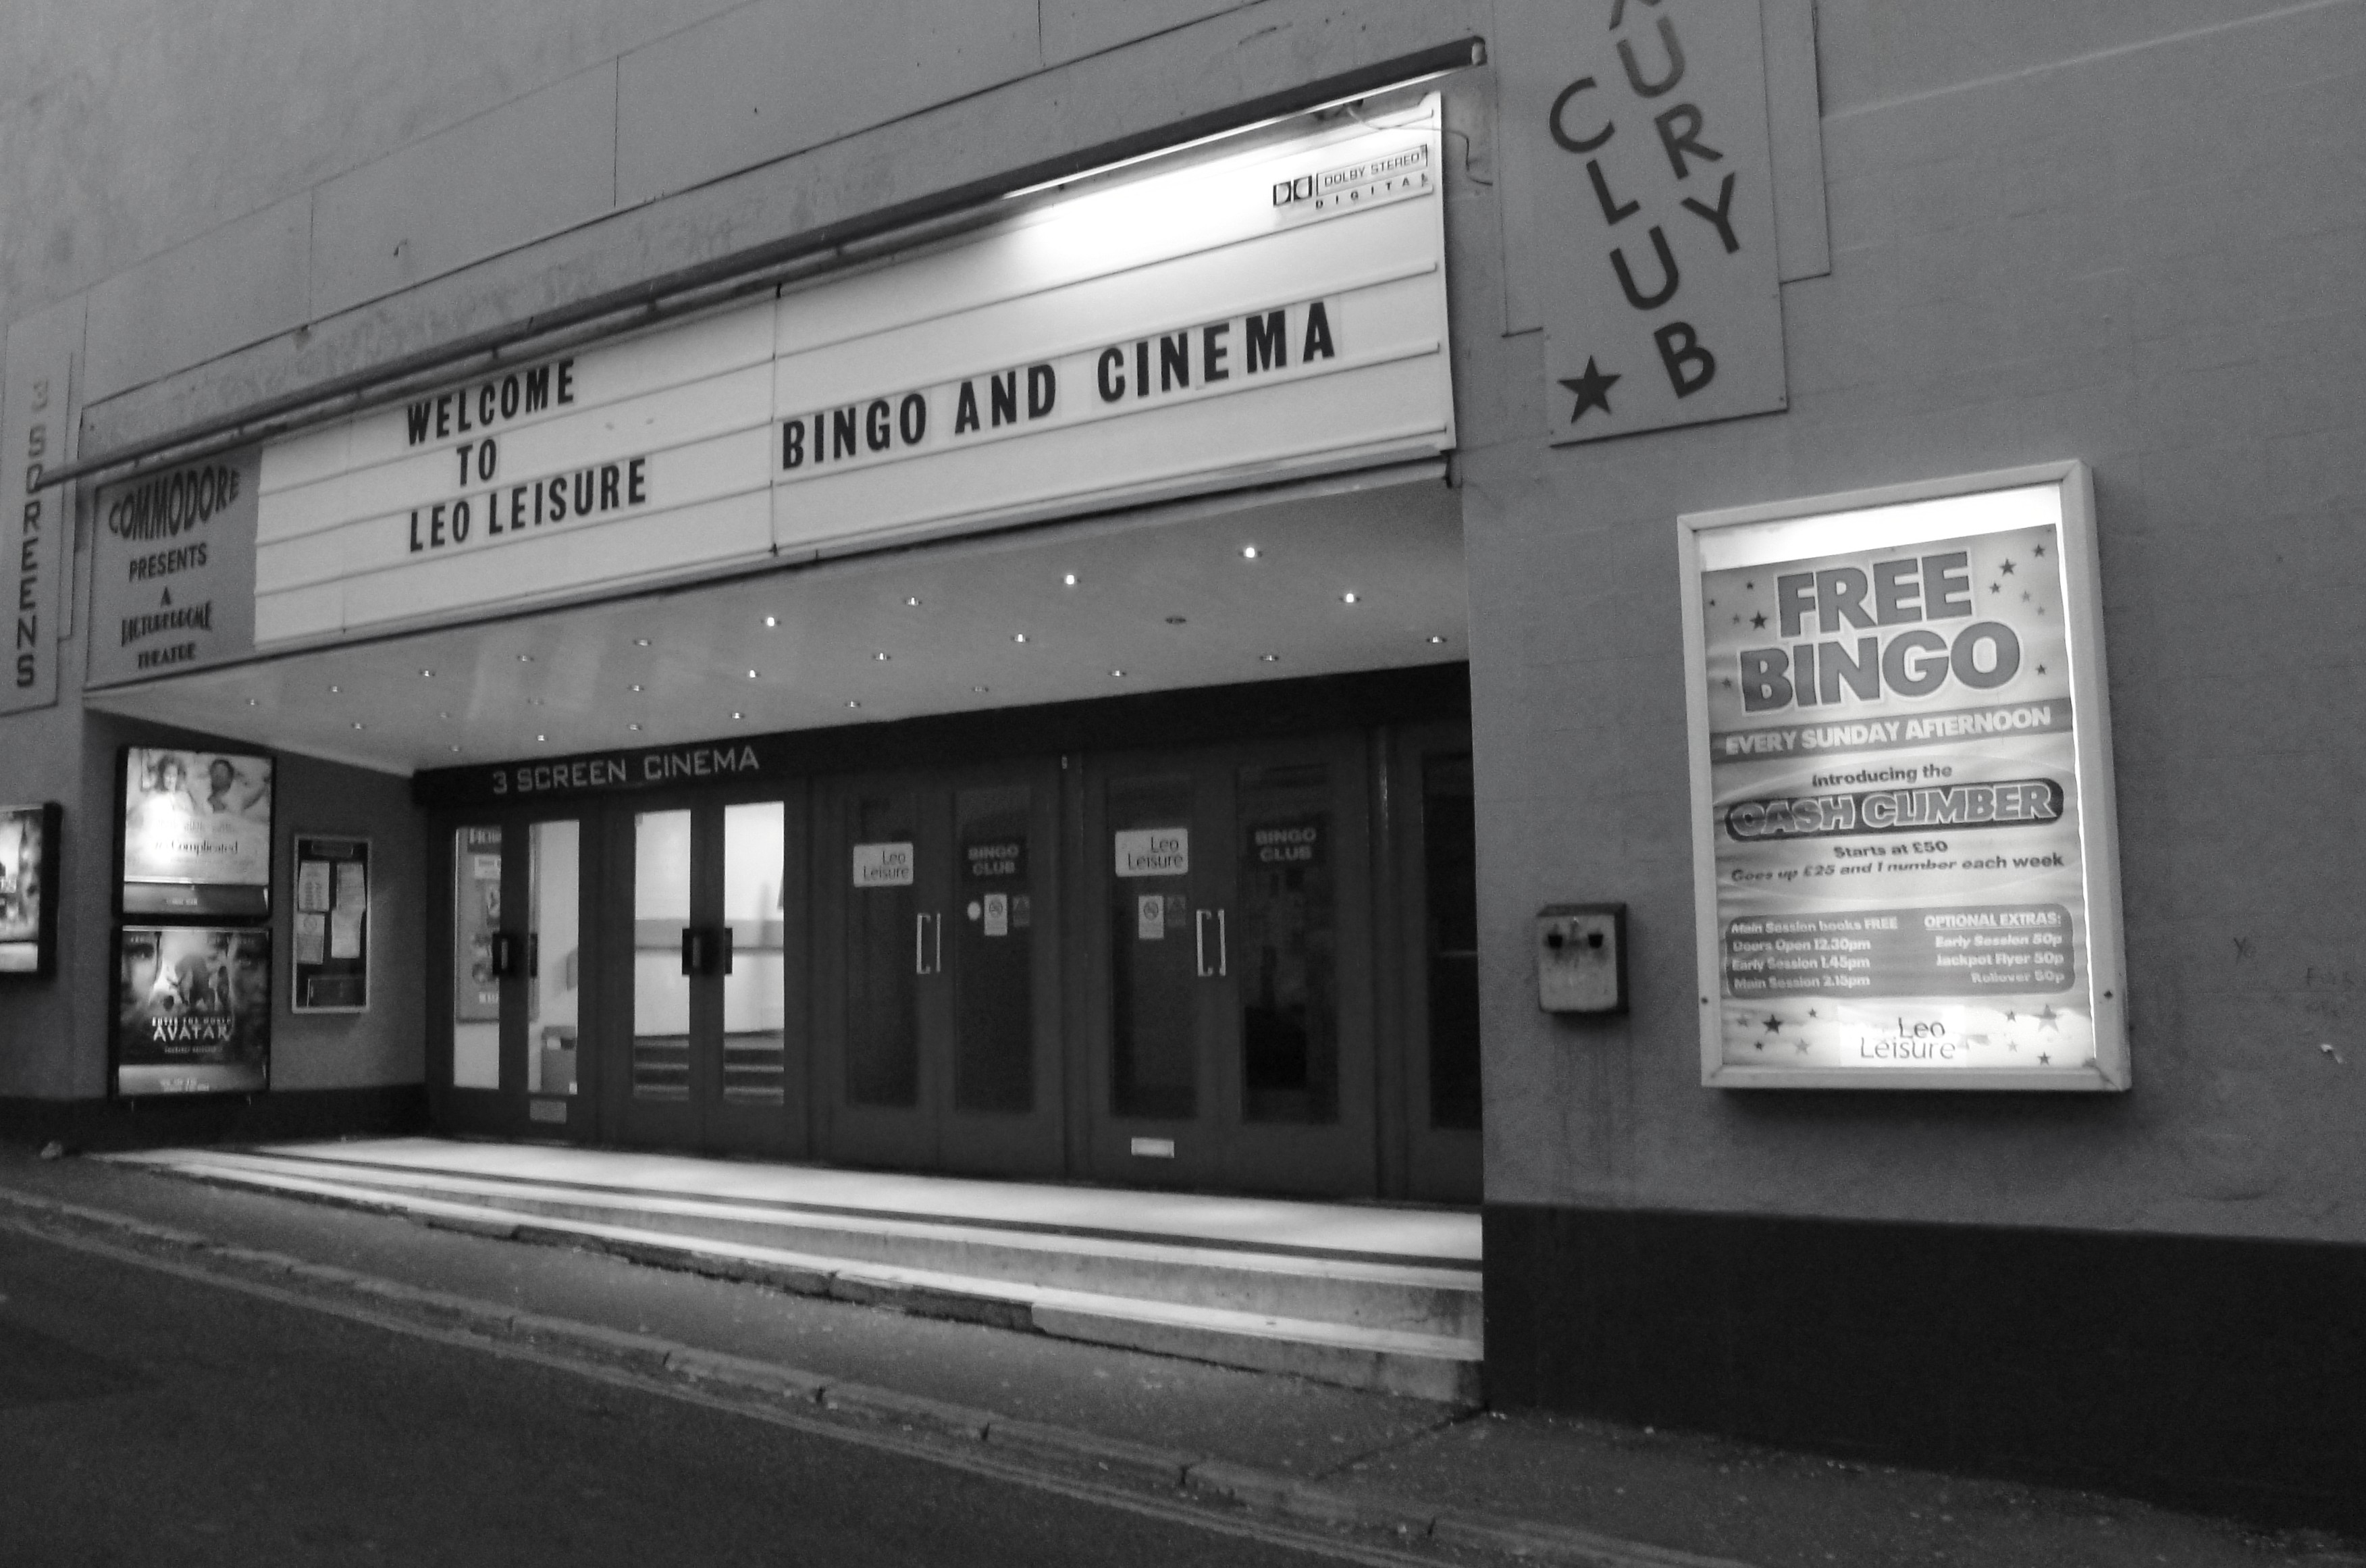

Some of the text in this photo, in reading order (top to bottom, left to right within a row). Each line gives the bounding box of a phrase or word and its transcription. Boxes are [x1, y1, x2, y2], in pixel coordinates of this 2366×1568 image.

[1609, 0, 1739, 254] URY
[1324, 153, 1419, 187] DOLBY STEREO
[1316, 173, 1428, 209] DIGITAL
[1549, 76, 1716, 399] CLUB
[782, 302, 1336, 470] BINGO AND CINEMA
[407, 359, 575, 446] WELCOME
[456, 439, 497, 487] TO
[109, 466, 240, 540] COMMODORE
[410, 458, 646, 552] LEO LEISURE
[16, 424, 46, 689] SCREENS
[129, 542, 207, 582] PRESENTS
[161, 587, 172, 607] A
[1776, 550, 1973, 639] FREE
[1739, 620, 2022, 714] BINGO
[1725, 706, 2051, 756] EVERY SUNDAY AFTERNOON
[493, 745, 760, 794] 3 SCREEN CINEMA
[1923, 764, 1952, 777] the
[1731, 783, 2057, 836] CASH CLIMBER
[1151, 836, 1180, 854] Leo
[1255, 827, 1317, 845] BINGO
[171, 839, 238, 856] Complicated
[968, 844, 1020, 861] BINGO
[1259, 844, 1313, 862] CLUB
[1834, 841, 1948, 858] Starts at £50
[882, 850, 906, 865] Leo
[1128, 852, 1184, 870] Leisure
[1731, 869, 1772, 882] Goes
[1778, 868, 1797, 882] up
[1803, 864, 1835, 877] £25
[1840, 862, 1872, 875] and
[1888, 859, 1957, 872] number
[1962, 856, 2007, 870] each
[2012, 852, 2064, 868] week
[863, 864, 909, 881] Leisure
[972, 860, 1016, 877] CLUB
[1731, 916, 1897, 934] Main Session books FREE
[1924, 912, 2061, 929] OPTIONAL EXTRAS:
[1733, 941, 1772, 952] Doors
[1775, 939, 1811, 953] Open
[1935, 932, 2063, 949] Early Session 50p
[1732, 958, 1764, 972] Early
[1767, 956, 1818, 969] Session
[1937, 950, 2064, 968] Jackpot Flyer 50p
[1734, 977, 1766, 989] Main
[1768, 976, 1820, 989] Session
[1971, 968, 2065, 984] Rollover 50p
[153, 1023, 232, 1042] AVATAR
[1898, 1017, 1945, 1039] Leo
[1860, 1037, 1955, 1060] Leisure
